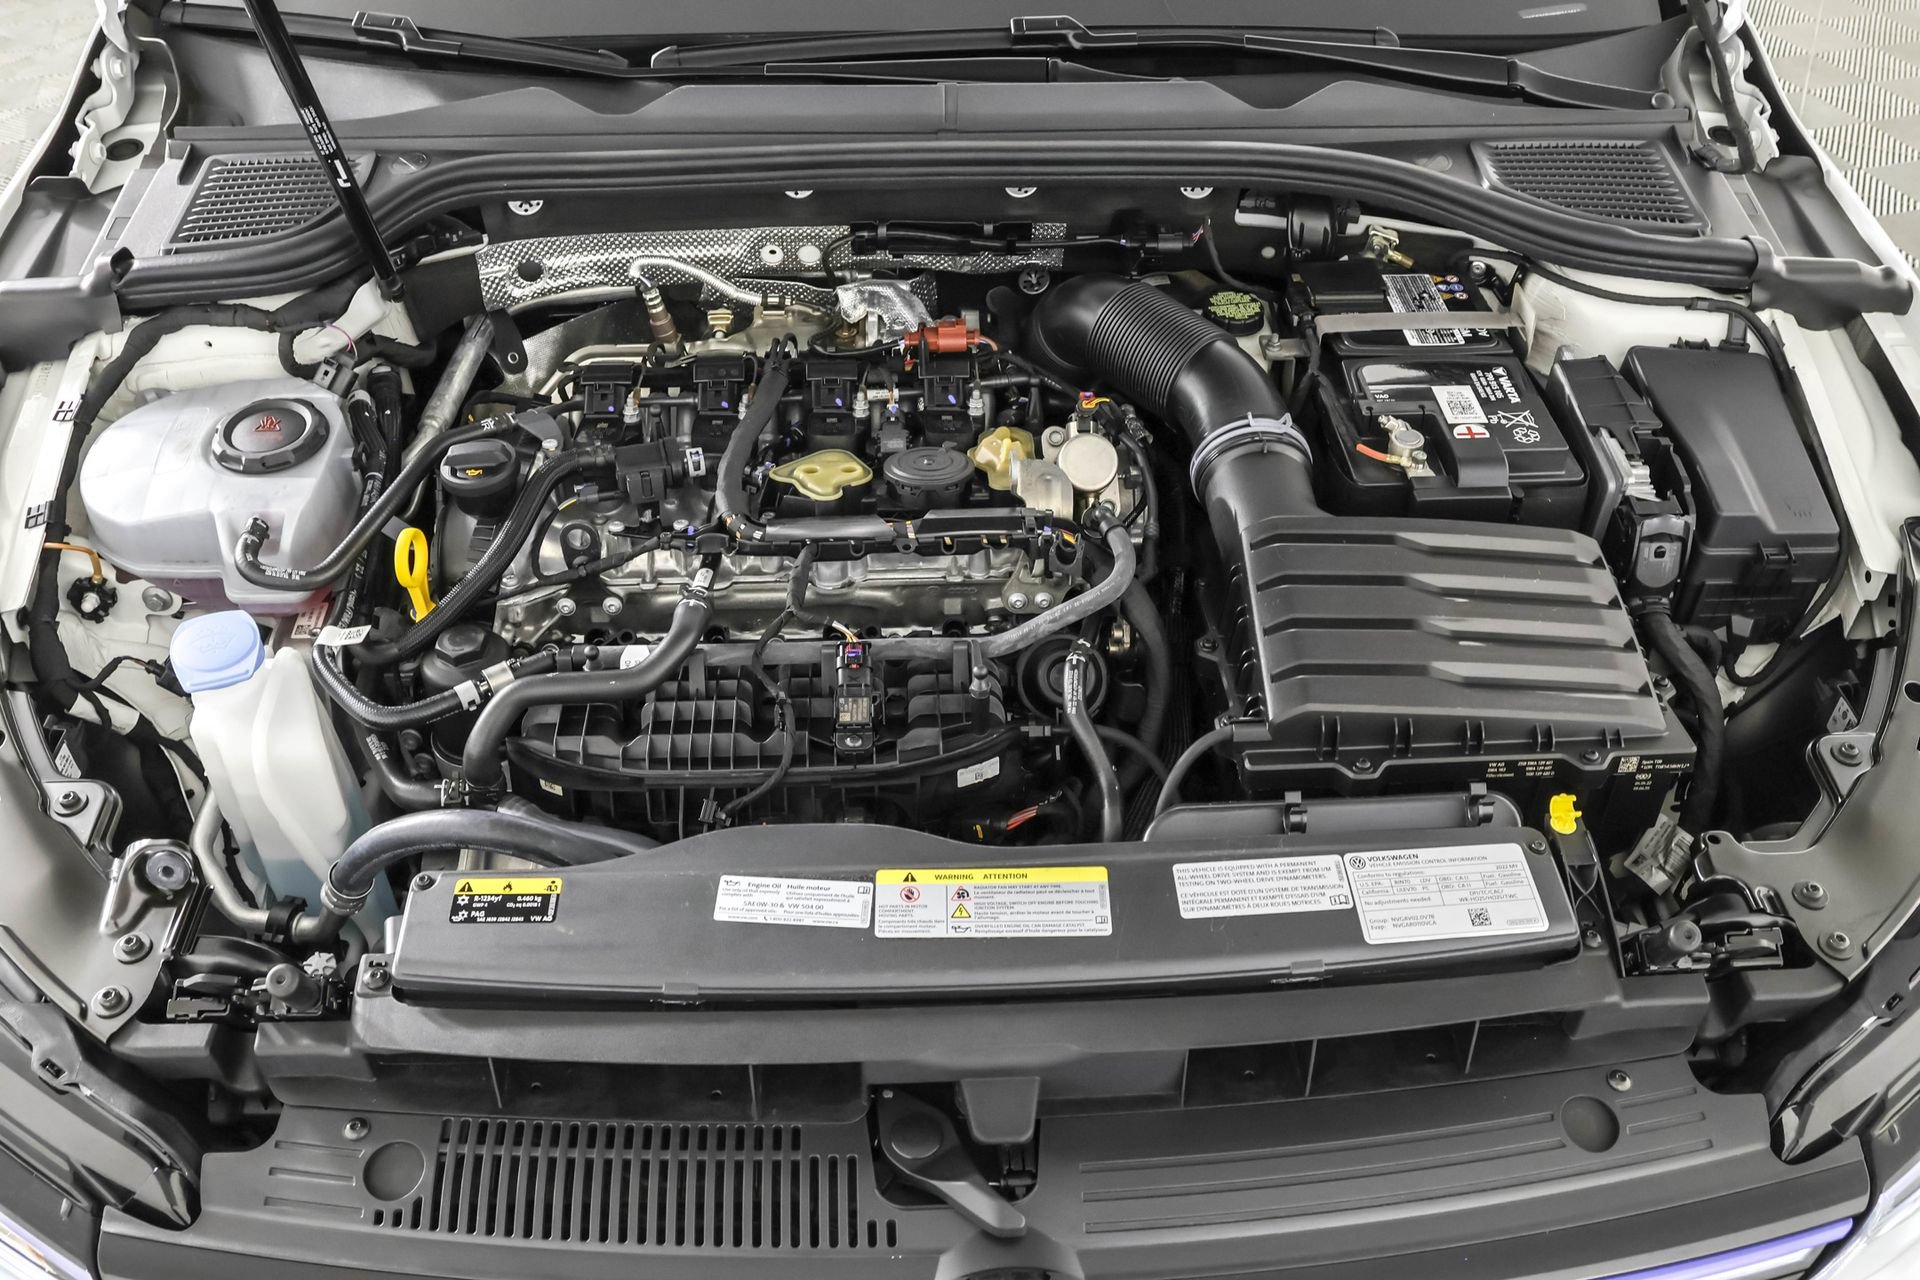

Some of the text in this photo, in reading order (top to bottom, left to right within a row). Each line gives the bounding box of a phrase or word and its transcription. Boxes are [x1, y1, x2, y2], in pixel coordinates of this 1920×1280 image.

[1499, 376, 1521, 404] VARTA
[1488, 415, 1499, 424] Pb
[1366, 853, 1419, 862] VOLKSWAGEN
[983, 872, 1028, 880] ATTENTION
[1275, 873, 1326, 881] DYNAMOMETERS.
[1189, 890, 1218, 898] VÉHICULE
[1299, 882, 1342, 890] TRANSMISSION
[473, 894, 502, 903] R-1234yf
[1373, 897, 1409, 905] adjustments
